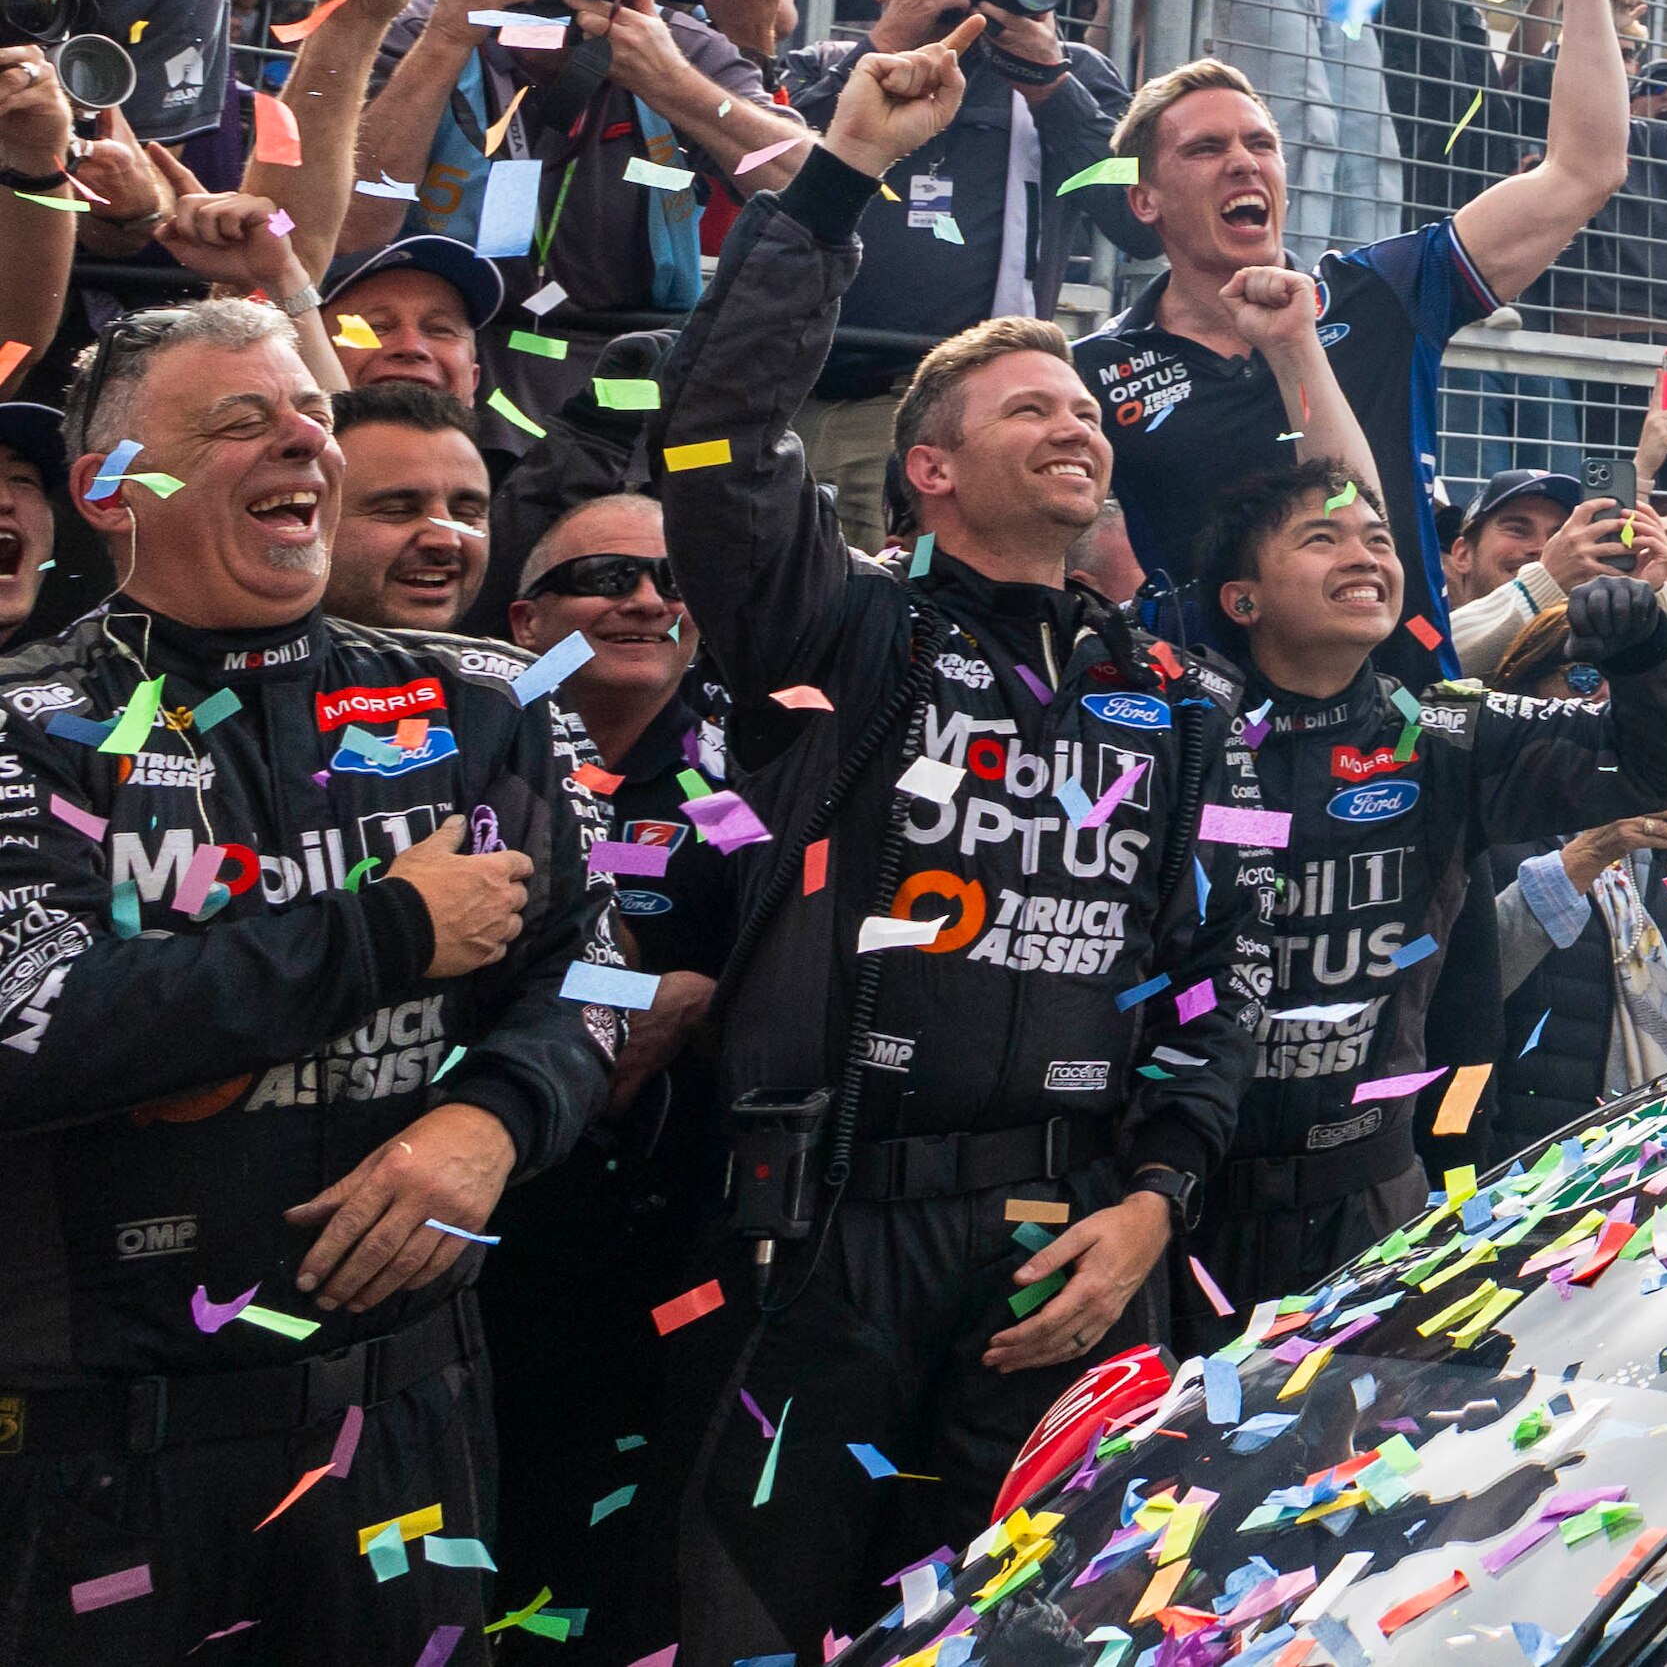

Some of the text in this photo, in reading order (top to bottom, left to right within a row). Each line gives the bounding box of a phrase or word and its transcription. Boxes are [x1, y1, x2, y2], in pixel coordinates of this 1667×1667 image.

[1099, 351, 1155, 385] Mobil
[1109, 363, 1188, 403] OPTUS
[1144, 381, 1192, 404] TRUCK
[1143, 389, 1191, 417] ASSIST
[224, 652, 291, 671] Mobil
[13, 687, 74, 714] OMP
[323, 686, 438, 719] MORRIS
[1103, 698, 1158, 724] Ford
[1421, 709, 1466, 731] OMP
[134, 750, 213, 772] TRUCK
[127, 766, 213, 790] ASSIST
[1354, 785, 1404, 811] Ford
[905, 793, 1150, 883] OPTUS
[998, 889, 1128, 938] TRUCK
[967, 929, 1124, 974] ASSIST
[322, 996, 444, 1061] RUCK
[245, 1040, 444, 1113] ASSIST
[1052, 1059, 1108, 1080] raceline
[116, 1222, 196, 1253] OMP
